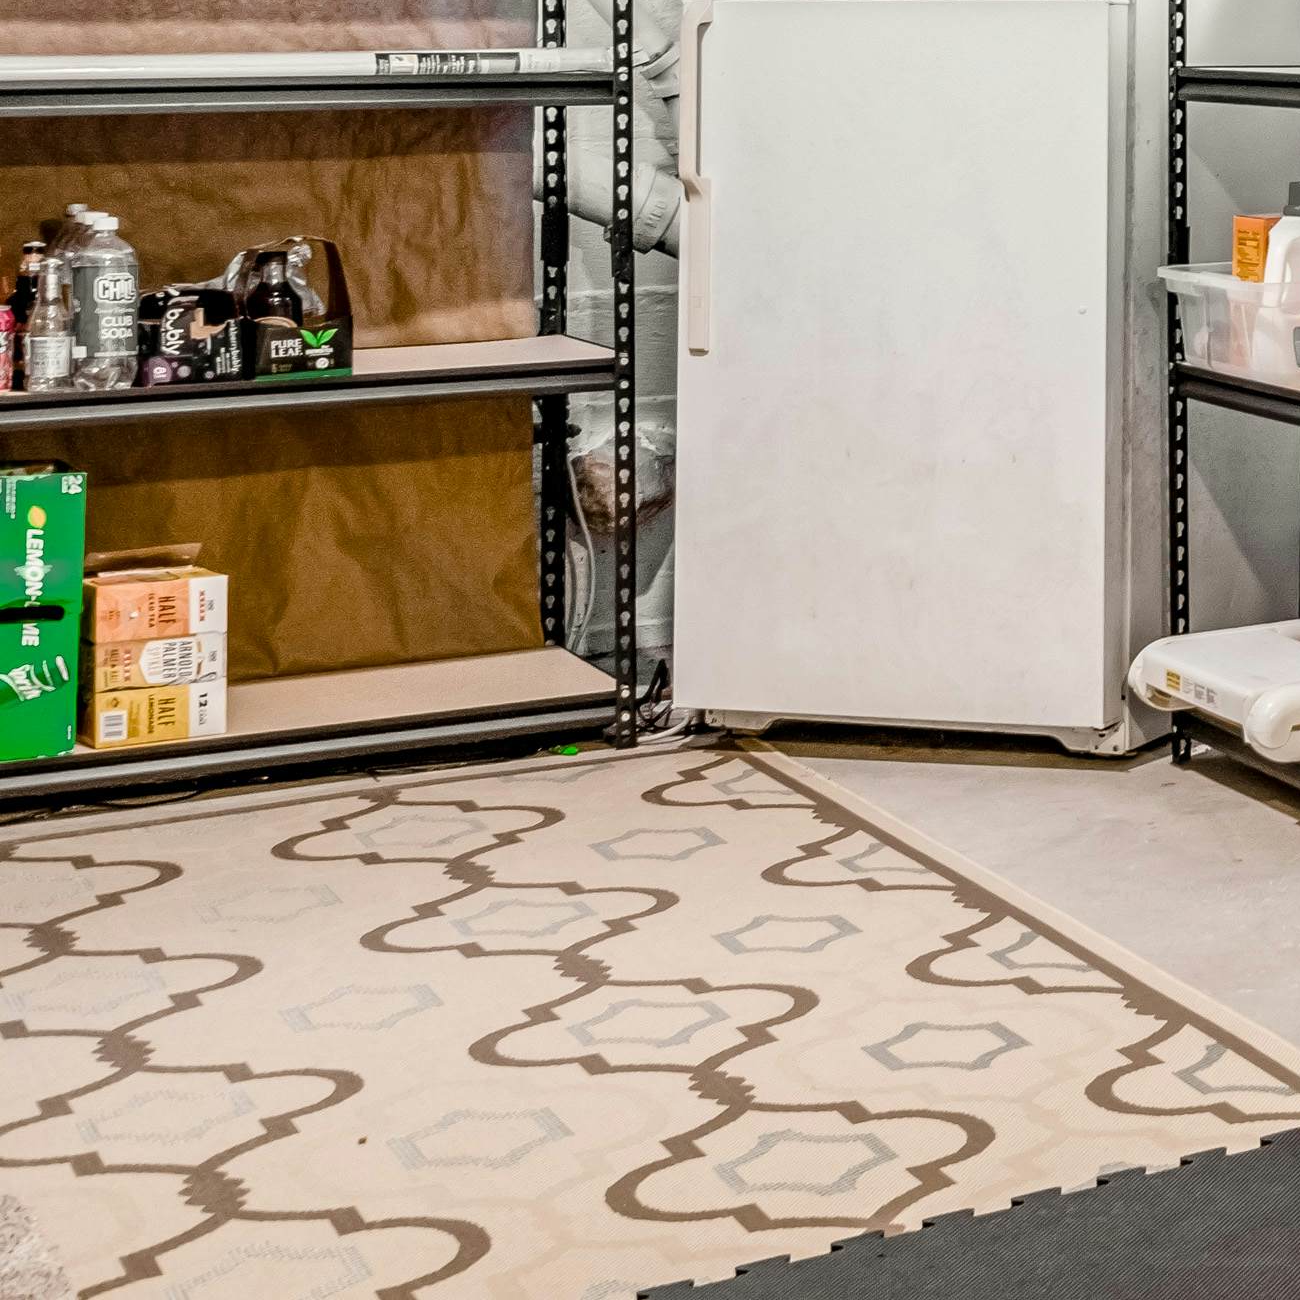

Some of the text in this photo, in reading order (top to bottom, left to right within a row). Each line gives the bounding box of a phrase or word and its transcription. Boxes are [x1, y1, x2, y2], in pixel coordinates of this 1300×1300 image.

[100, 327, 134, 339] SODA
[101, 315, 134, 327] CLUB
[161, 308, 185, 356] bubly
[271, 338, 302, 349] PURE
[66, 475, 83, 494] 24
[158, 596, 176, 624] HALF
[162, 642, 177, 679] PALMER
[178, 641, 193, 677] ARNOLD
[147, 693, 156, 734] LEMONADE
[157, 697, 176, 727] HALF
[199, 692, 208, 708] 12
